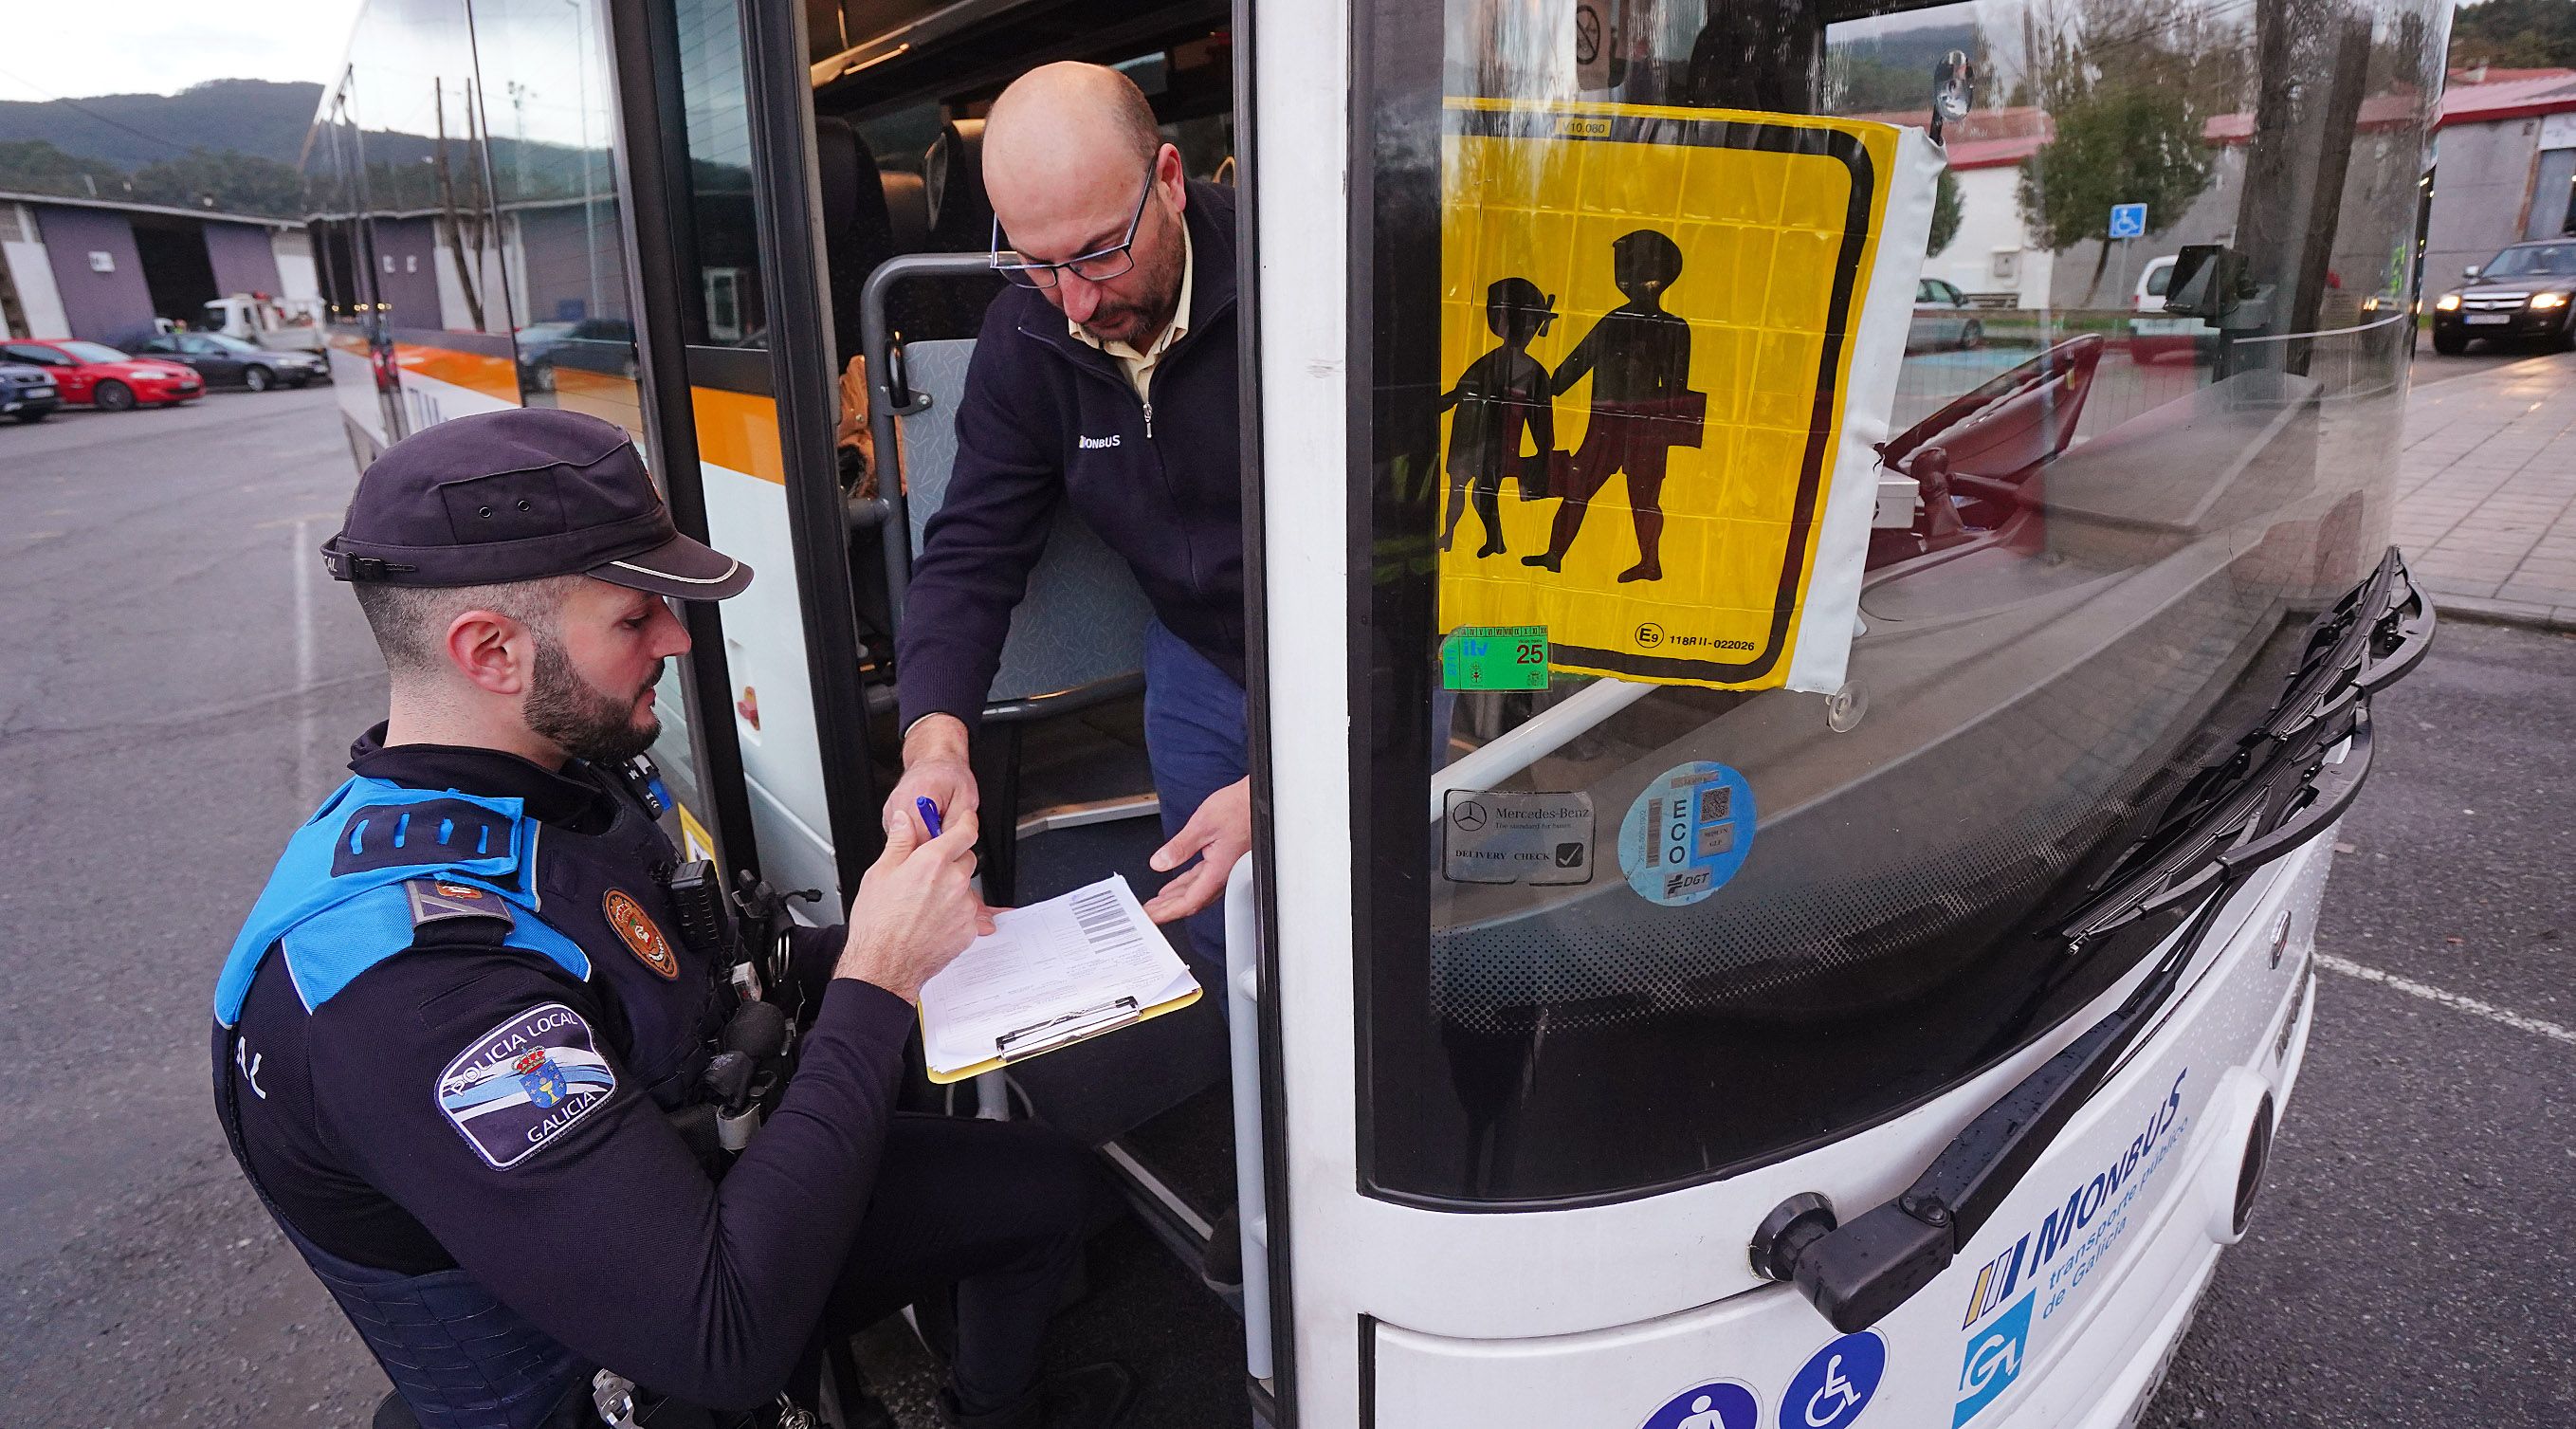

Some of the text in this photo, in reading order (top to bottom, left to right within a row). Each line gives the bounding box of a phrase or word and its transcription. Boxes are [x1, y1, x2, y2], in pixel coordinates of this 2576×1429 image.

[1562, 122, 1605, 134] V10.080
[1638, 628, 1659, 643] E9
[1463, 638, 1489, 657] itv
[1516, 644, 1544, 665] 25
[1495, 807, 1590, 819] Mercedes-Benz
[1669, 799, 1688, 864] ECO
[1455, 850, 1550, 861] DELIVERY CHECK
[1683, 872, 1710, 888] DGT
[449, 1012, 578, 1097] POLICIA LOCAL
[527, 1090, 597, 1143] GALICIA
[2048, 1182, 2138, 1291] transporte
[2042, 1216, 2128, 1320] de Galicia
